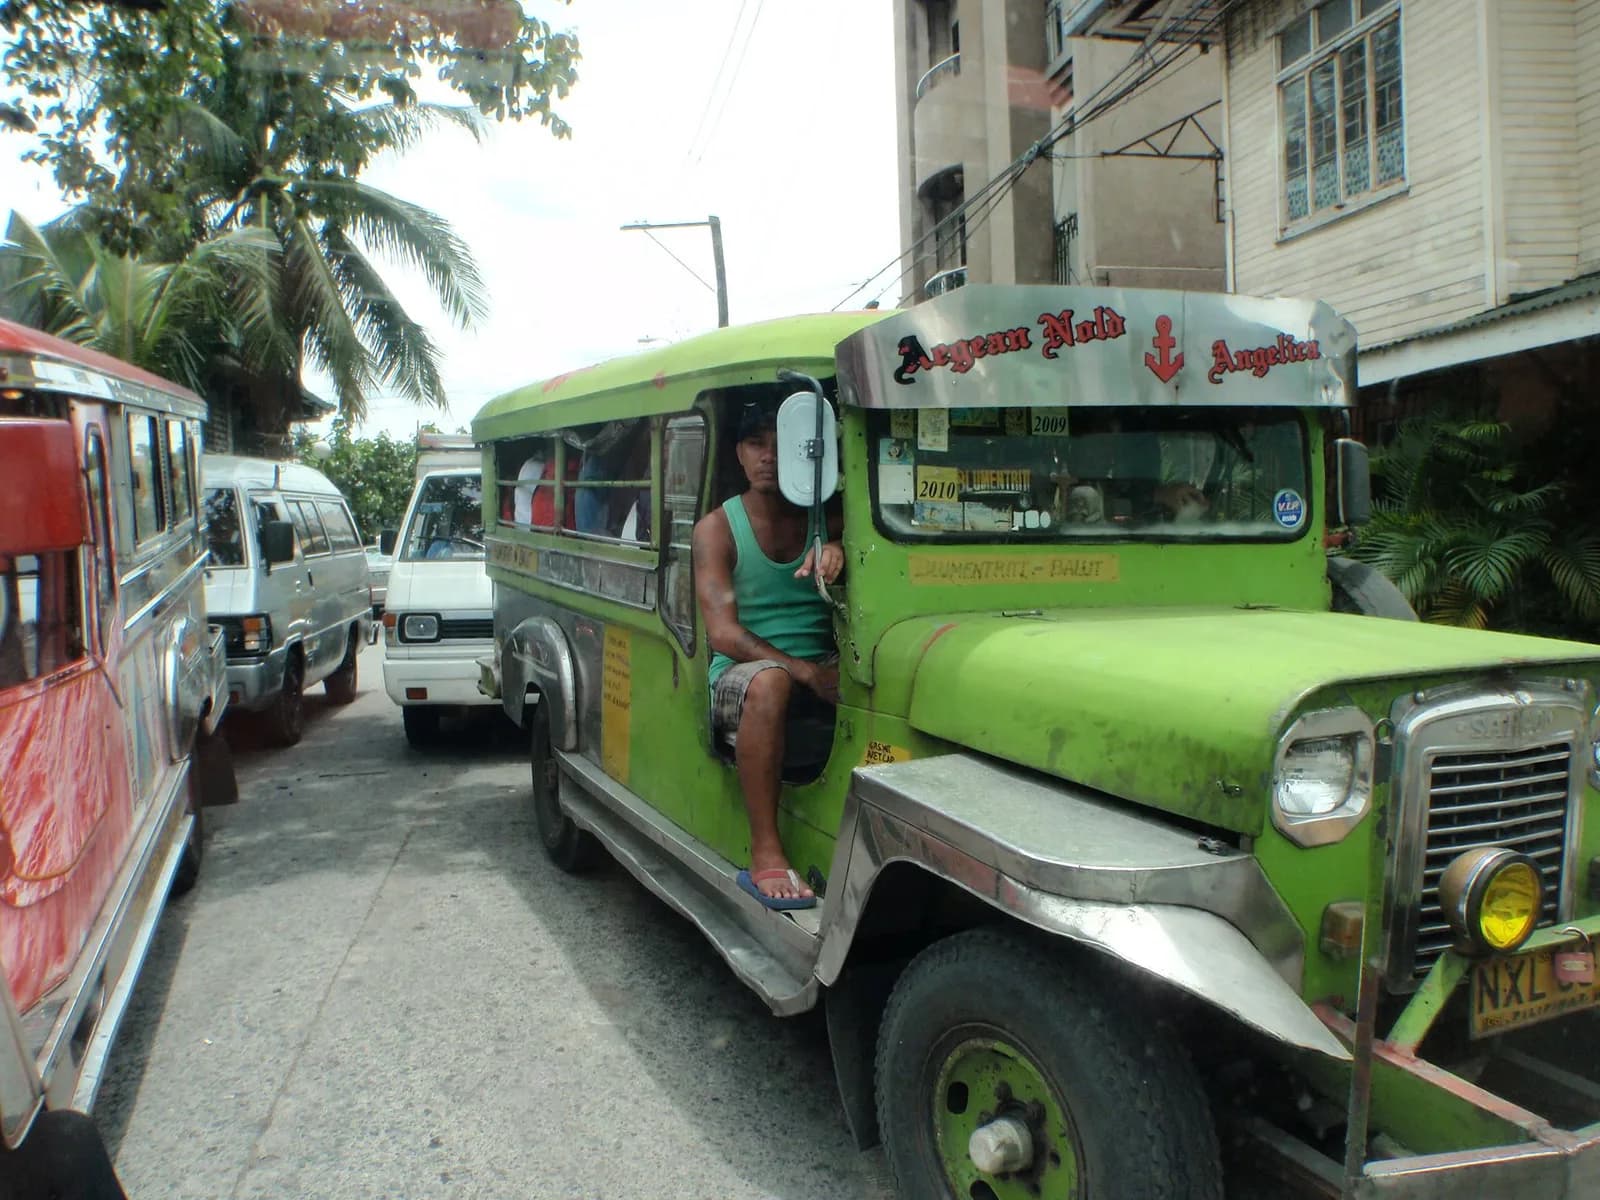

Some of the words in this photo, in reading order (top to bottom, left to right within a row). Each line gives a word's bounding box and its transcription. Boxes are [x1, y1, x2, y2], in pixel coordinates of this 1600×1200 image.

[1037, 306, 1126, 359] Nold
[1208, 333, 1321, 384] Angelica
[1034, 415, 1067, 433] 2009
[920, 480, 956, 499] 2010
[1478, 957, 1546, 1014] NXL
